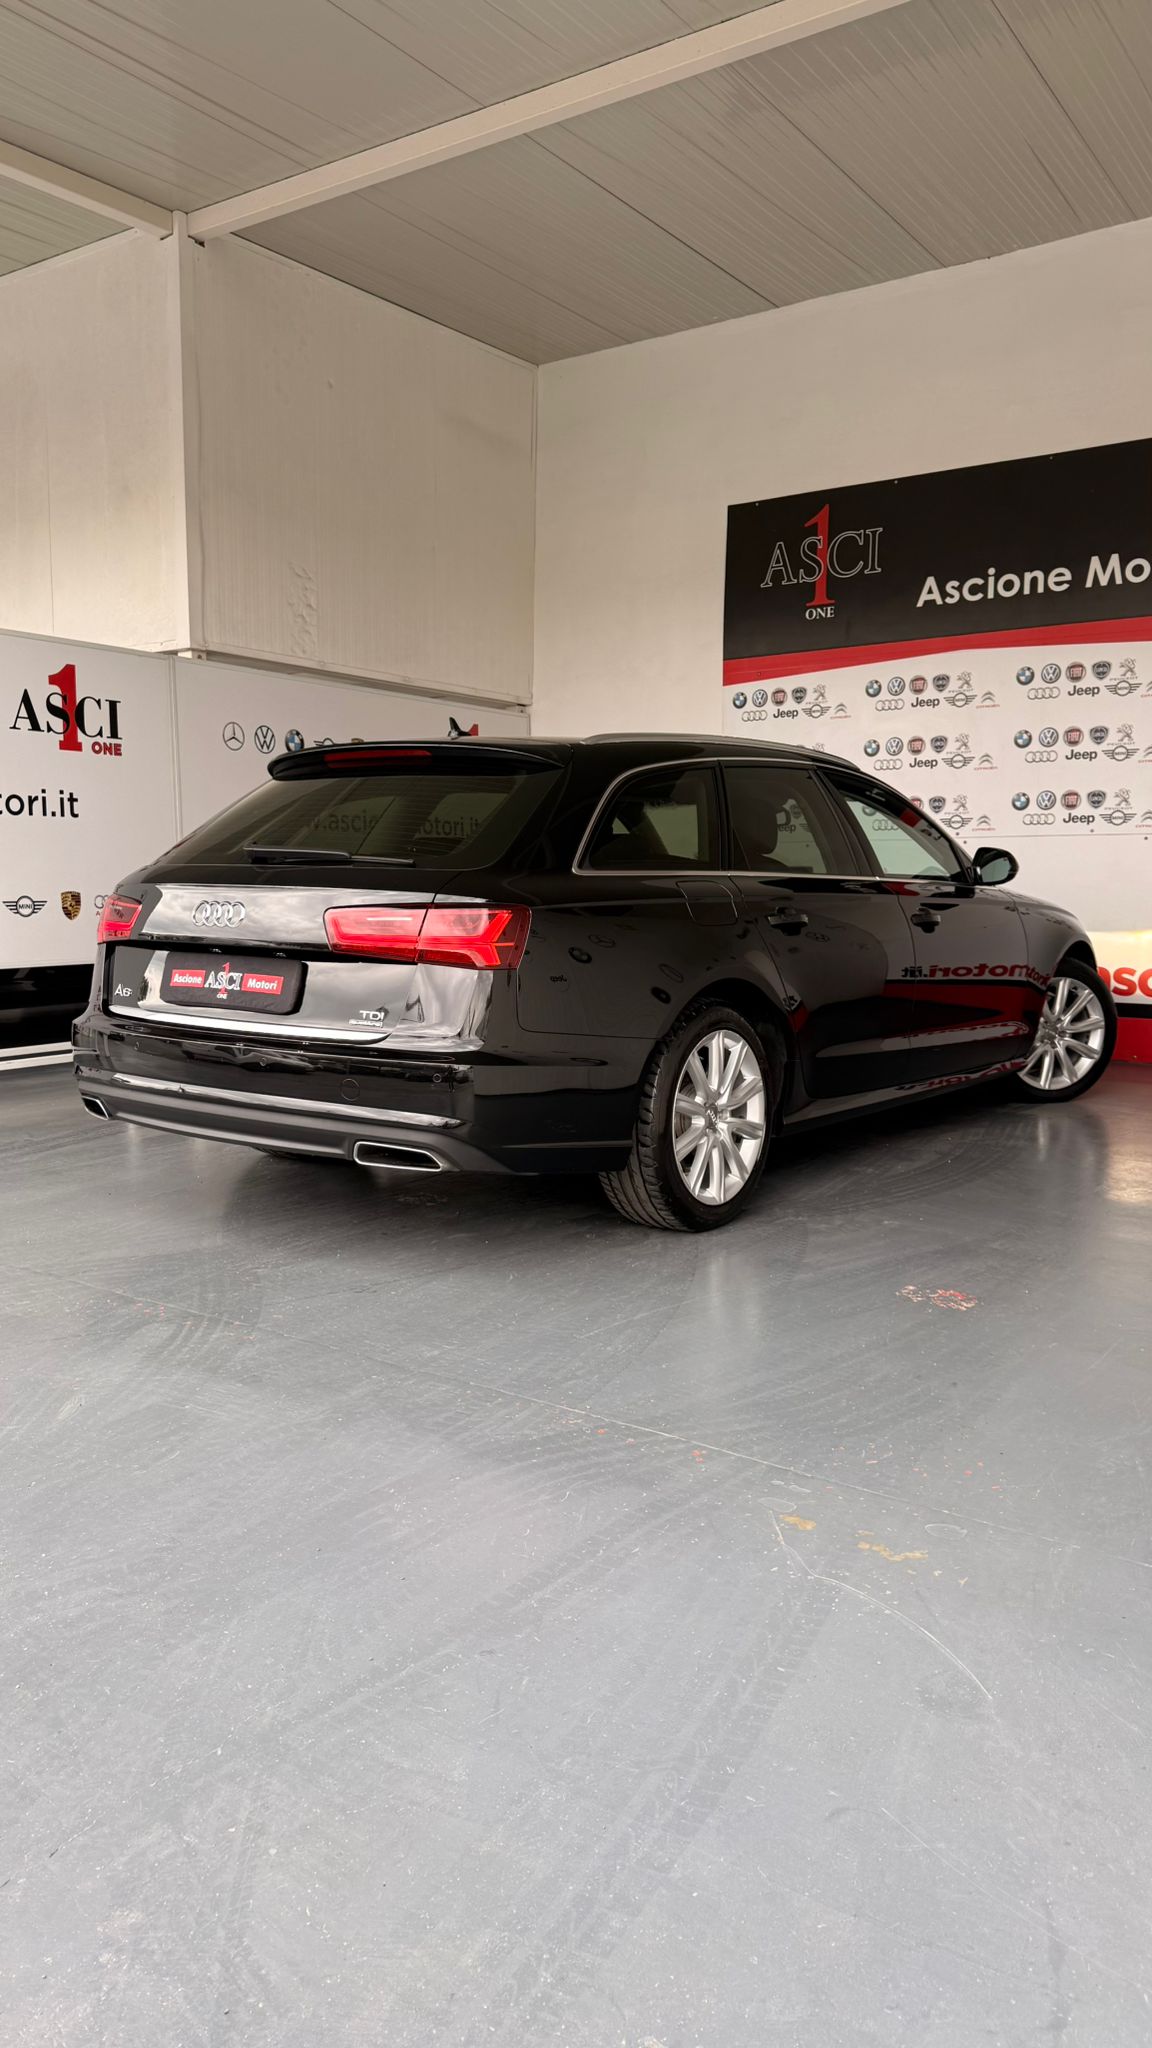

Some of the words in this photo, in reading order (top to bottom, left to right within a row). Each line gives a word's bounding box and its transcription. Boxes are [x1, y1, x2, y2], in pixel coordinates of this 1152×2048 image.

[760, 527, 883, 588] ASCI
[916, 567, 1072, 608] Ascione
[1085, 553, 1152, 588] Mo
[805, 606, 835, 620] ONE
[1068, 685, 1100, 697] Jeep
[911, 697, 940, 708] Jeep
[9, 688, 123, 740] ASCI
[773, 709, 799, 719] Jeep
[91, 741, 123, 757] ONE
[1065, 749, 1098, 761] Jeep
[909, 758, 938, 769] Jeep
[0, 788, 79, 818] ori.it
[1063, 813, 1095, 825] Jeep
[778, 824, 796, 834] eep
[173, 973, 203, 984] Ascione
[204, 971, 243, 990] ASCI
[247, 978, 278, 990] Motori
[360, 1010, 384, 1021] TDI
